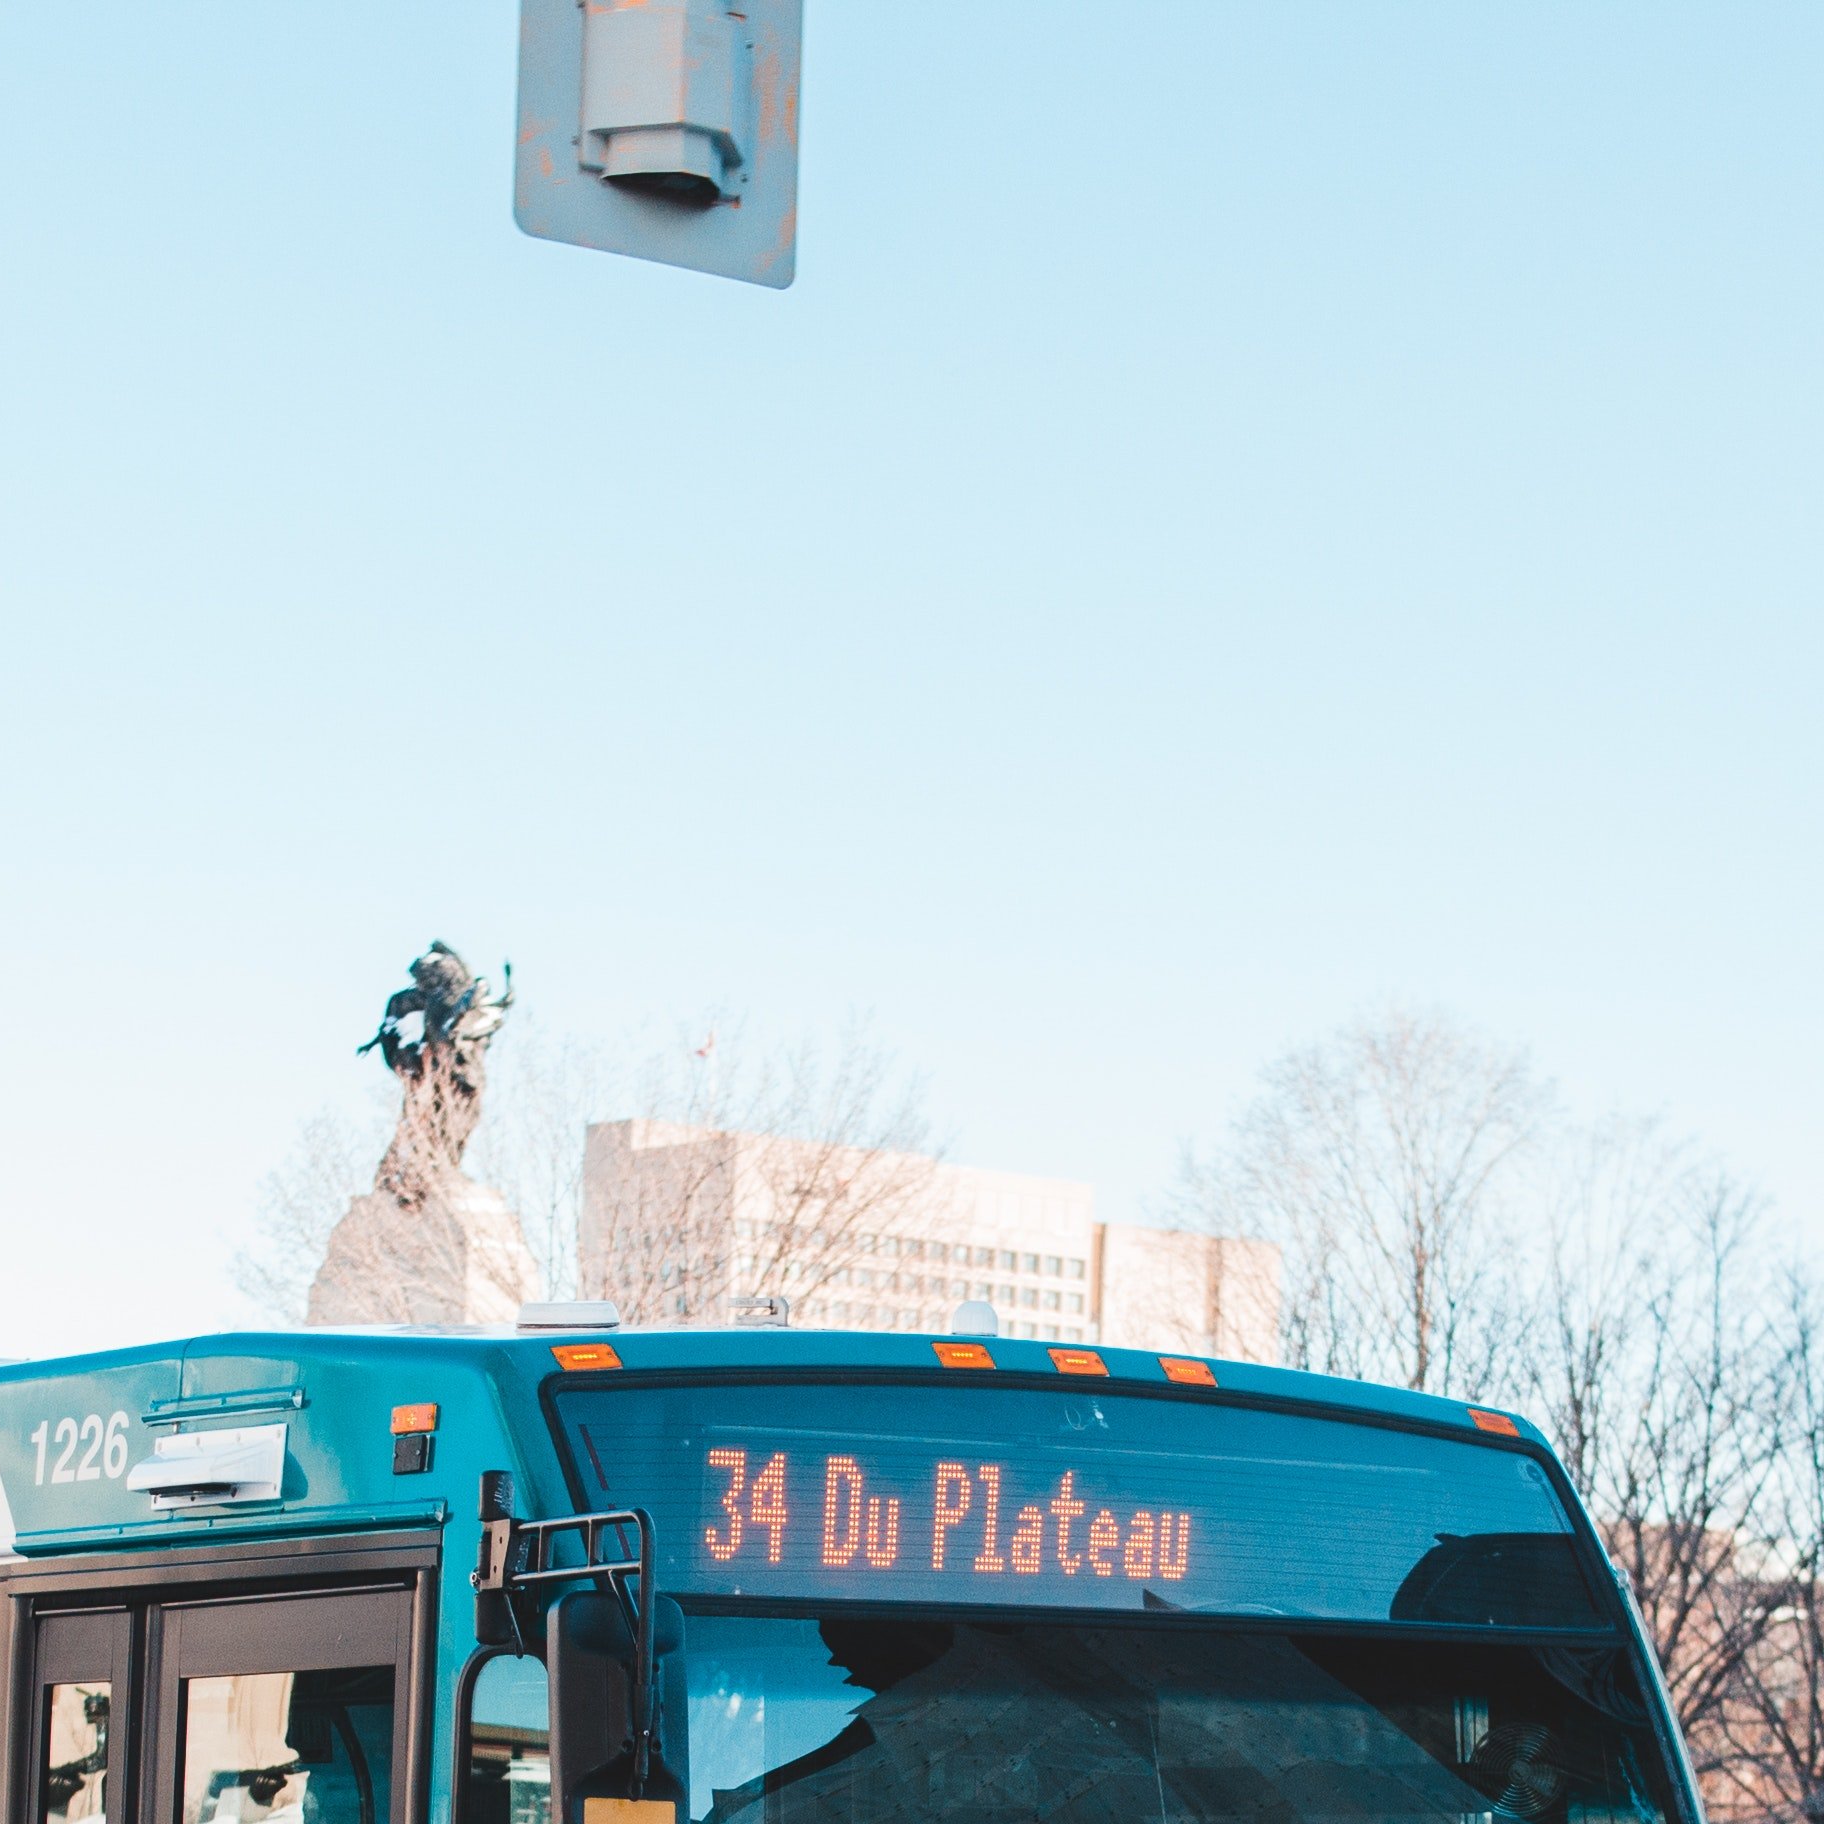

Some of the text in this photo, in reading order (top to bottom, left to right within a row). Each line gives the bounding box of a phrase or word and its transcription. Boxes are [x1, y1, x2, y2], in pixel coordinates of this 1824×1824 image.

[31, 1410, 130, 1487] 1226
[704, 1447, 1192, 1581] 34 Du Plateau
